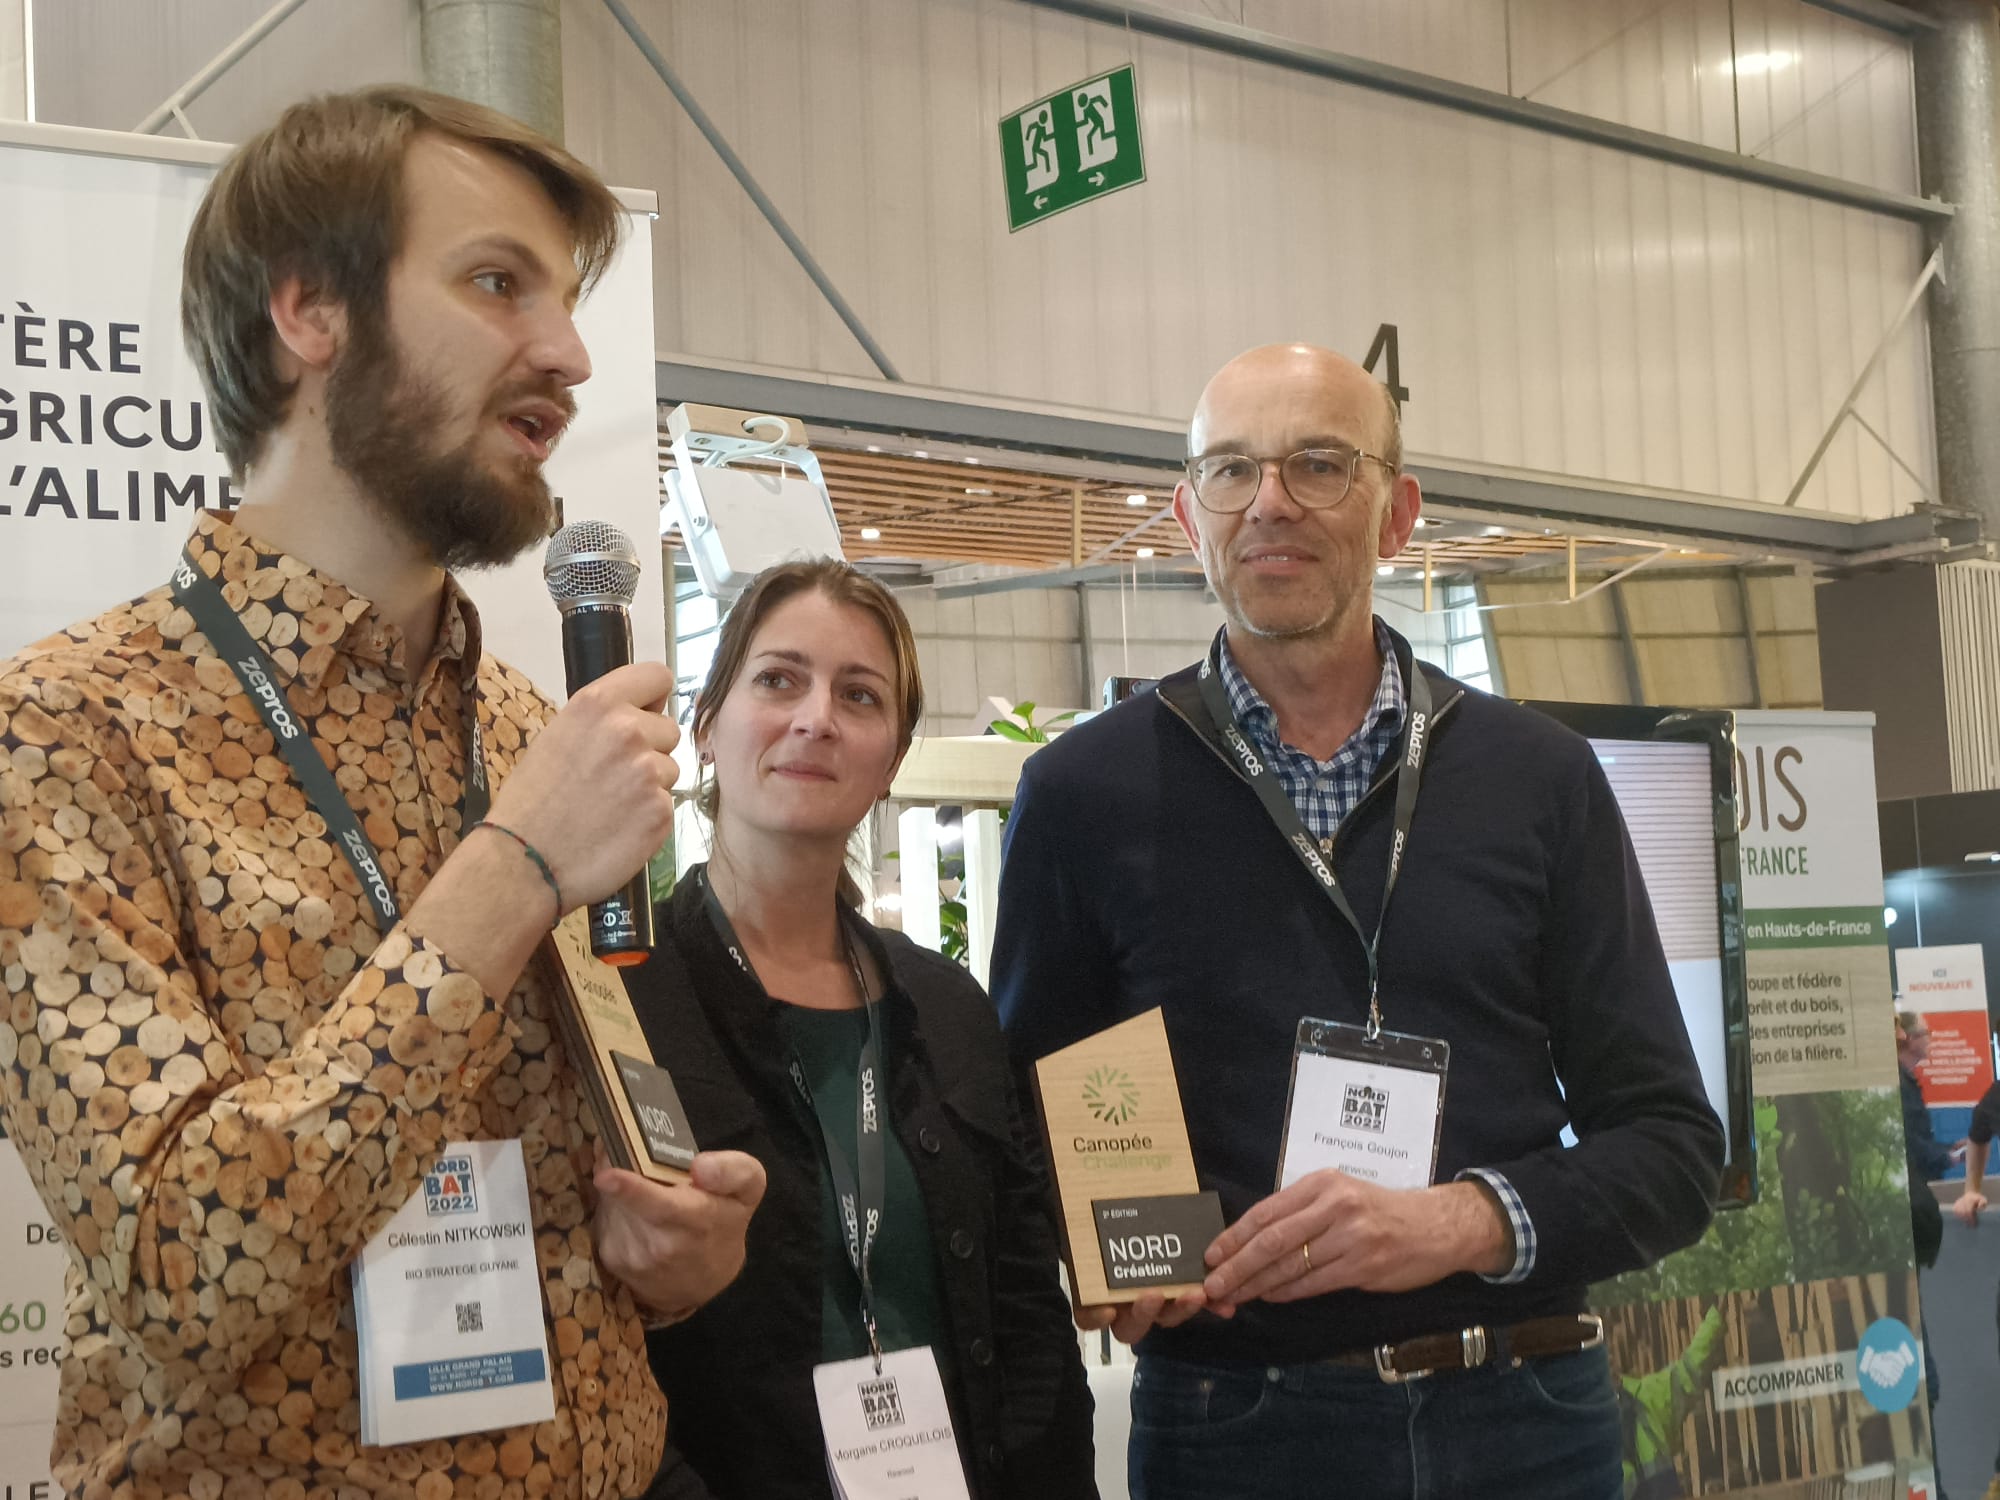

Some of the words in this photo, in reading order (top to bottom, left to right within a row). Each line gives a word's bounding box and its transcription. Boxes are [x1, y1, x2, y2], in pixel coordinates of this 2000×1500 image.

[0, 301, 141, 374] ÈRE
[1362, 323, 1409, 423] 4
[0, 387, 224, 453] GRICU
[1747, 926, 1763, 938] en
[1764, 920, 1872, 938] Hauts-de-France
[1747, 976, 1779, 993] oupe
[1782, 975, 1795, 990] et
[1797, 971, 1842, 989] fédère
[1776, 999, 1788, 1014] et
[1790, 997, 1807, 1013] du
[1810, 995, 1843, 1013] bois,
[1772, 1019, 1846, 1040] entreprises
[1774, 1048, 1789, 1064] de
[1792, 1047, 1803, 1062] la
[1805, 1044, 1848, 1062] filière.
[1345, 1098, 1385, 1118] BAT
[637, 1103, 675, 1138] NORD
[1344, 1114, 1382, 1129] 2022
[1073, 1133, 1152, 1153] Canopée
[1314, 1132, 1363, 1151] François
[1367, 1142, 1408, 1160] Goujon
[425, 1174, 471, 1197] BAT
[429, 1195, 474, 1212] 2022
[388, 1231, 441, 1249] Célestin
[445, 1223, 526, 1245] NITKOWSKI
[1108, 1233, 1182, 1263] NORD
[405, 1270, 423, 1281] BIO
[425, 1263, 479, 1279] STRATEGE
[480, 1260, 519, 1271] GUYANE
[1113, 1262, 1173, 1280] Création
[861, 1381, 894, 1396] NORD
[1724, 1362, 1844, 1398] ACCOMPAGNER
[864, 1393, 897, 1414] BAT
[868, 1410, 901, 1428] 2022
[880, 1427, 952, 1452] CROQUELOIS
